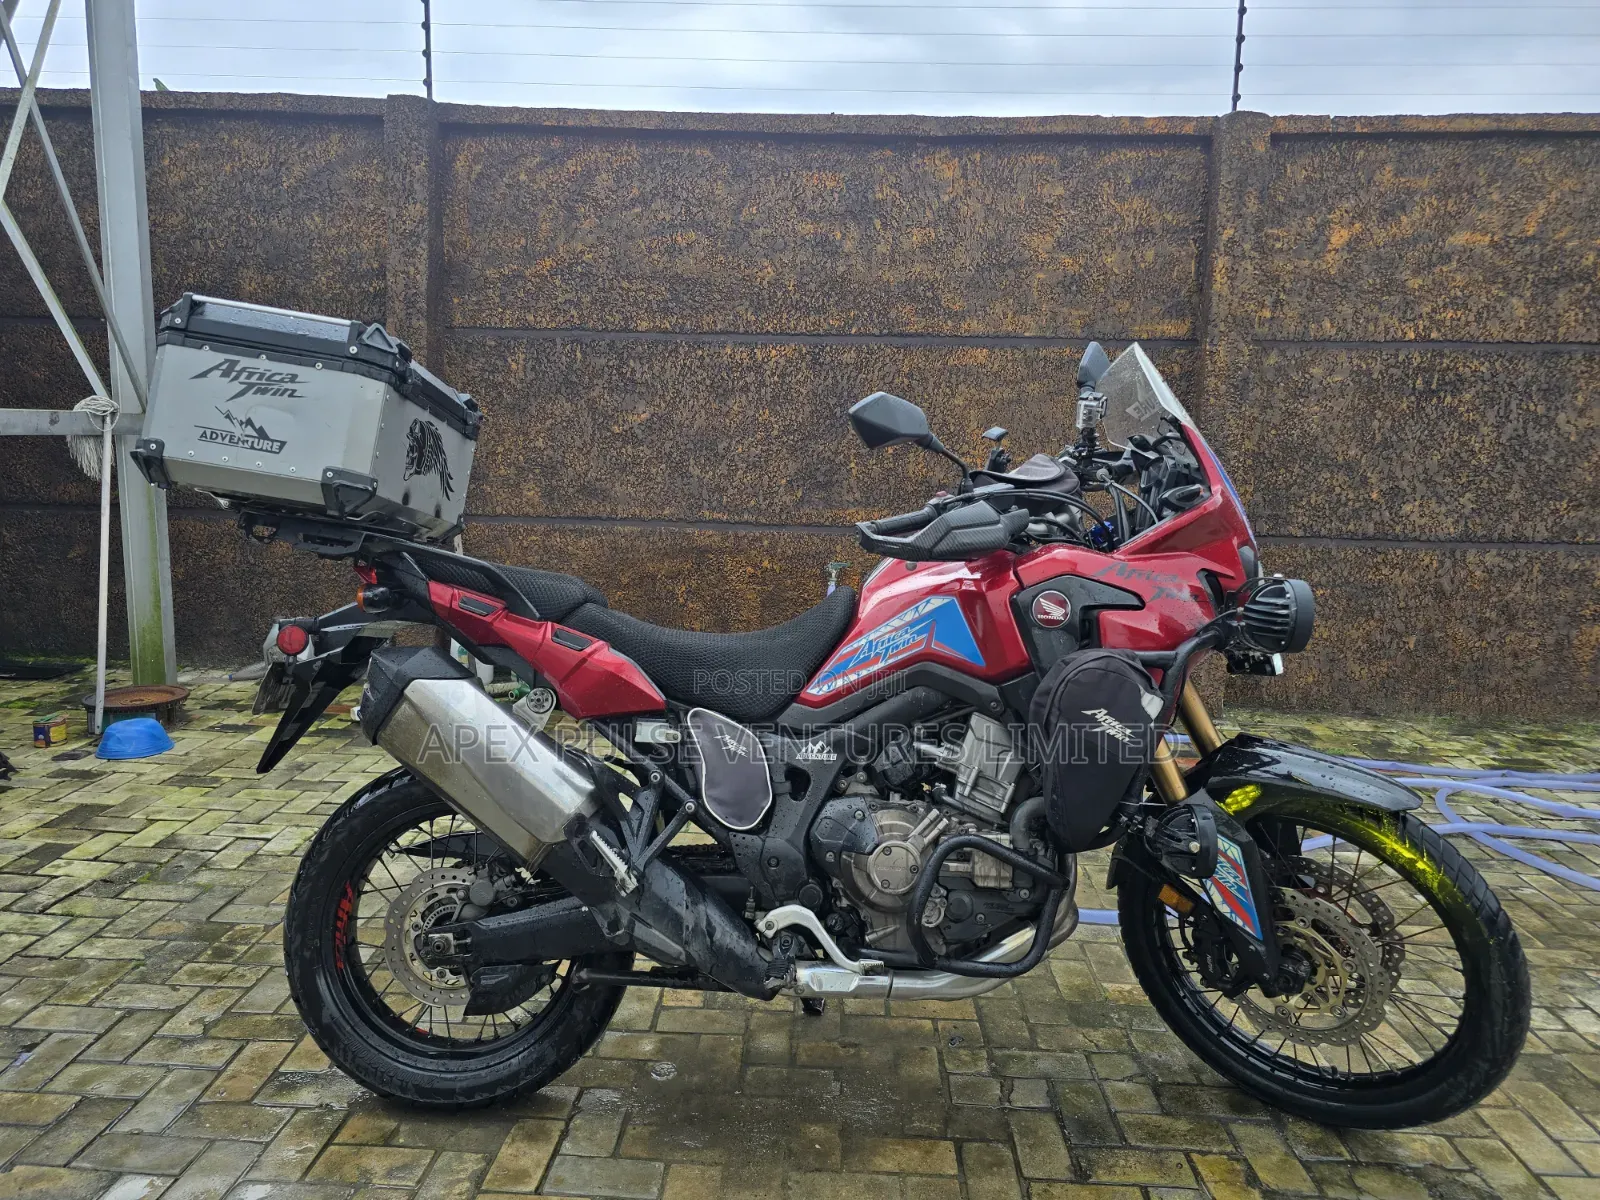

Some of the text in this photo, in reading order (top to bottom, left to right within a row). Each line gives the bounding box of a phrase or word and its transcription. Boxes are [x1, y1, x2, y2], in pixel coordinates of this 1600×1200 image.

[188, 358, 311, 384] Africa
[225, 381, 307, 402] Twin
[199, 430, 282, 453] ADVENTURE
[847, 618, 934, 669] Africa
[878, 632, 929, 666] Twin
[1080, 707, 1137, 739] Africa
[795, 753, 838, 761] ADVENTURE
